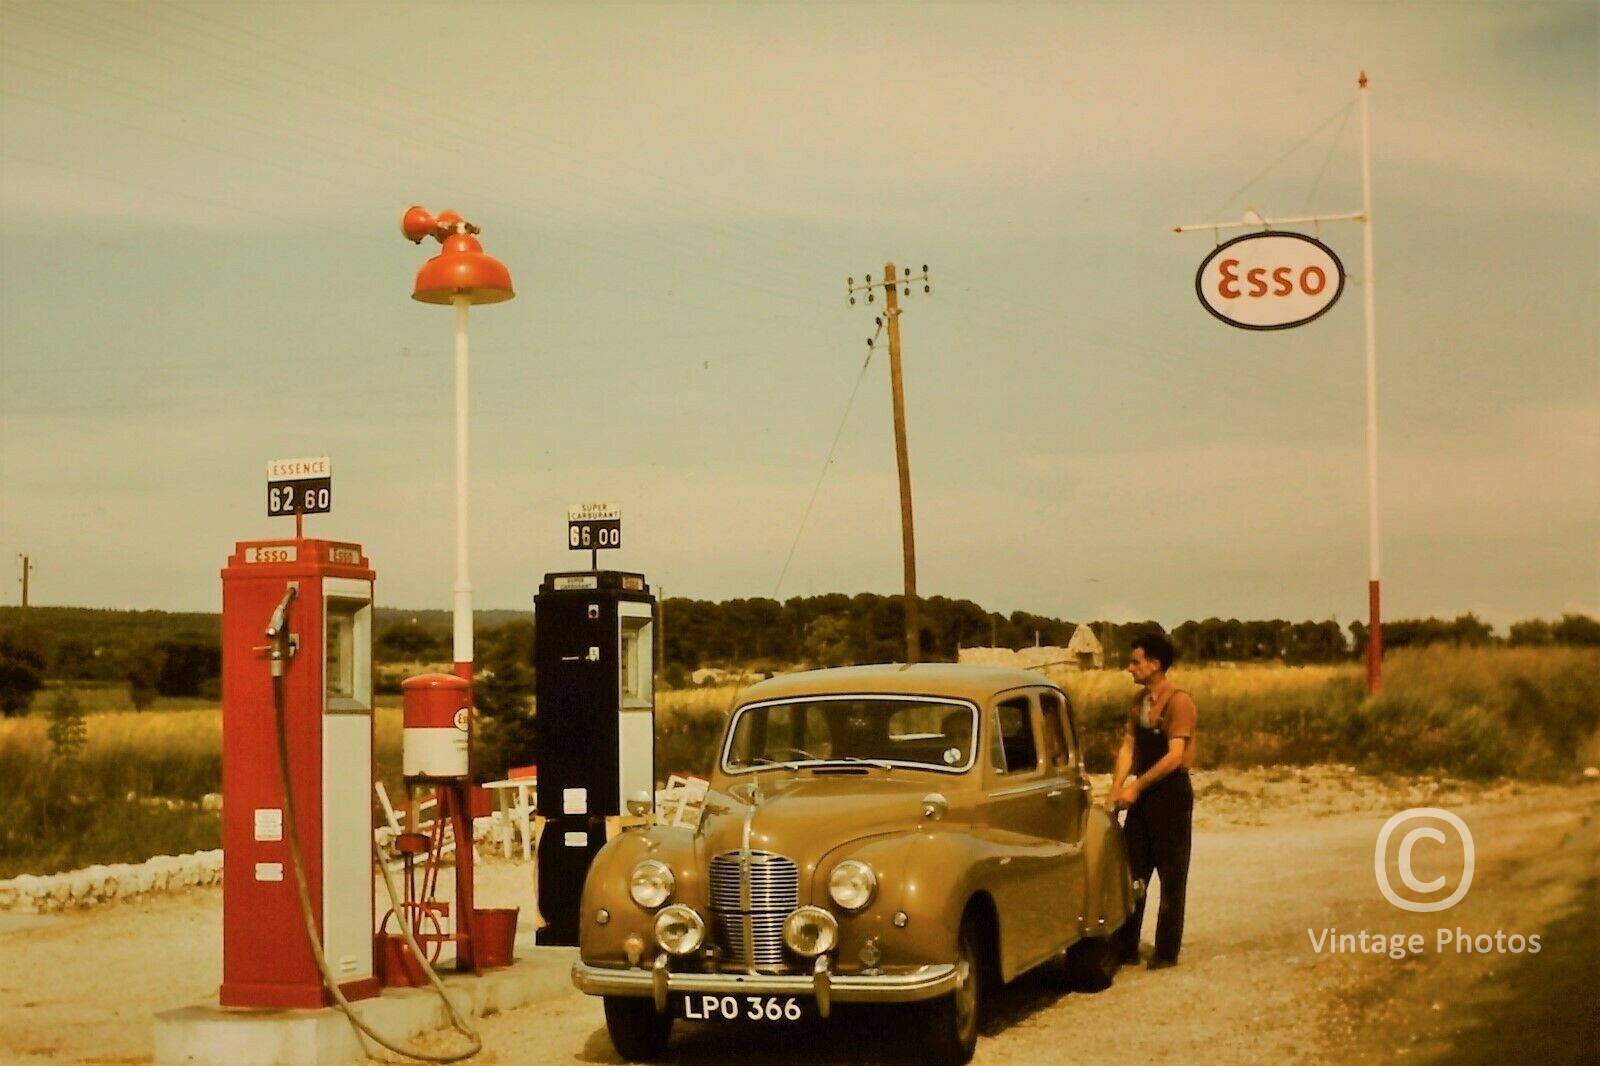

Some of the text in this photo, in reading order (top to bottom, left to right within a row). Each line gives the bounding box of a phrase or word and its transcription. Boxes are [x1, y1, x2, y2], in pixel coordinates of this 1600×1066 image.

[1218, 259, 1326, 299] Esso
[273, 462, 325, 475] ESSENCE
[269, 486, 329, 513] 62 60
[581, 503, 607, 511] SUPER
[571, 511, 618, 519] CARBURANT
[570, 525, 620, 547] 66 00
[684, 995, 802, 1021] LPO 366
